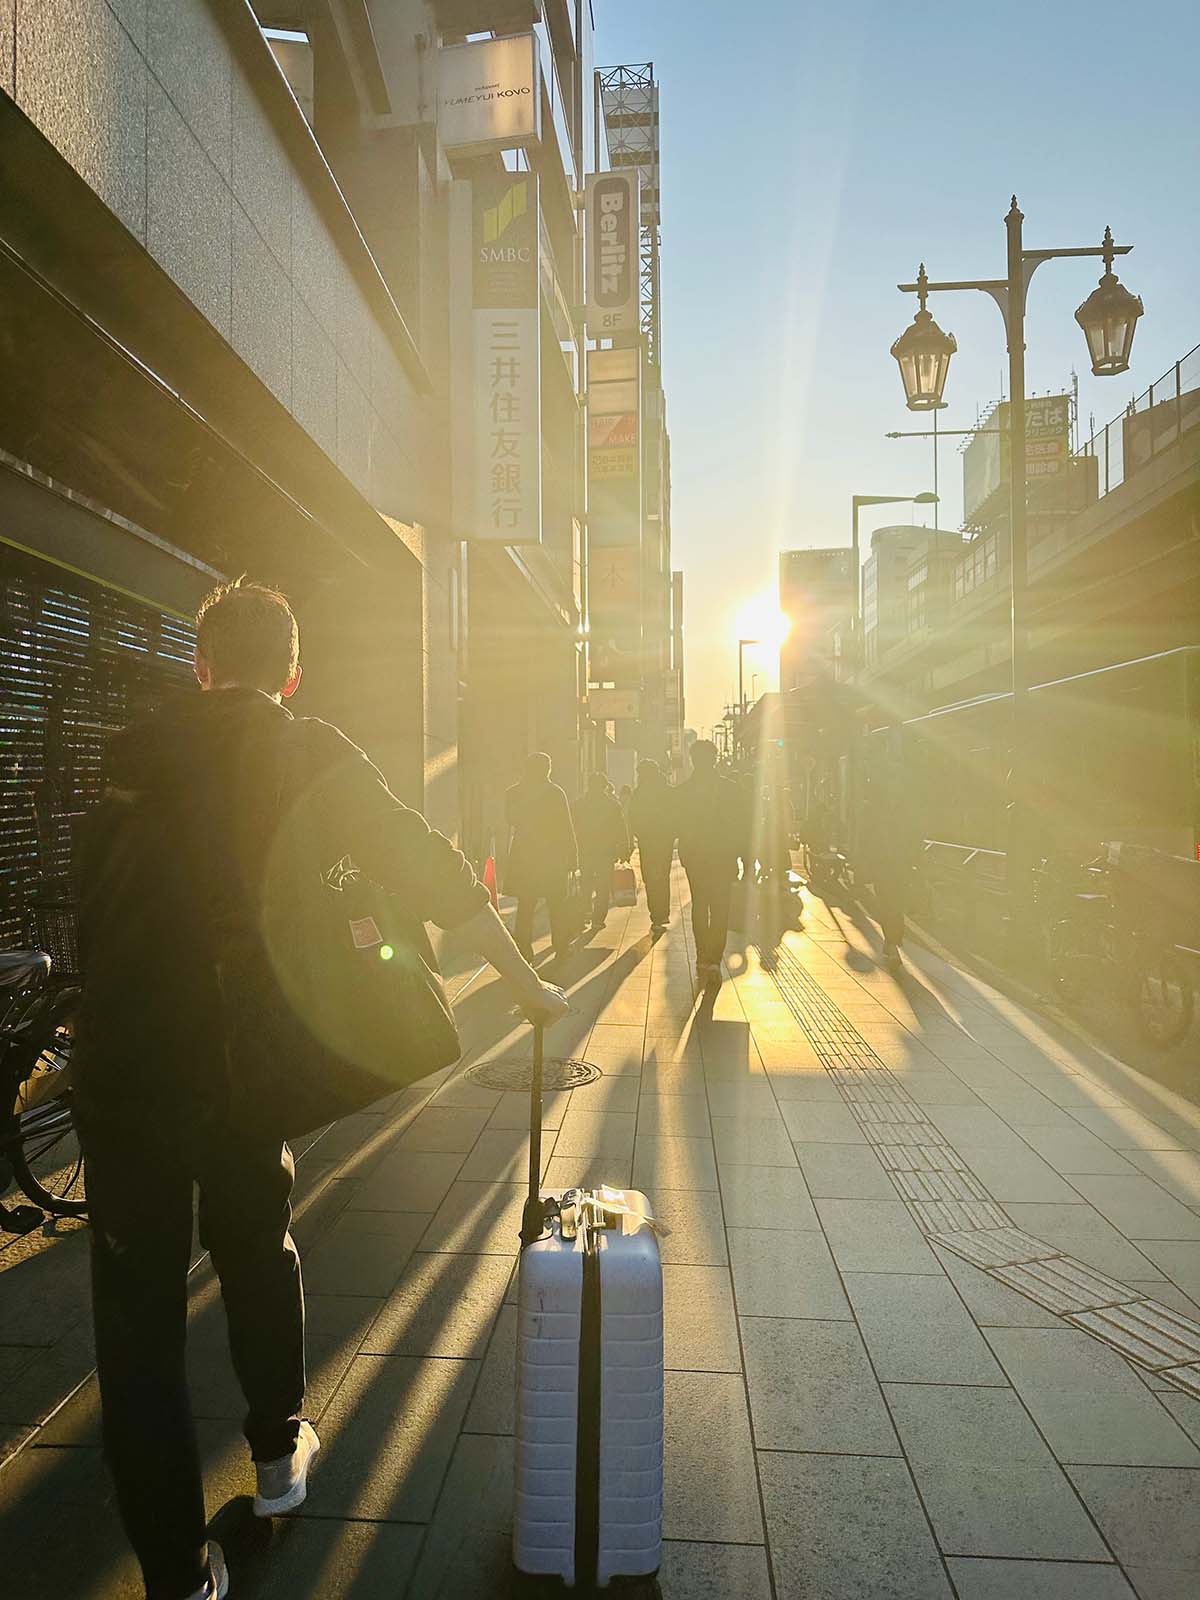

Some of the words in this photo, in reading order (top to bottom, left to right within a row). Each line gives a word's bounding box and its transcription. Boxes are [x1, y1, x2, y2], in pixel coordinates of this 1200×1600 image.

[497, 87, 531, 98] KOVO
[600, 192, 626, 294] Berlitz
[480, 247, 531, 263] SMBC
[602, 313, 622, 328] 8F
[490, 322, 522, 529] 三井住友銀行
